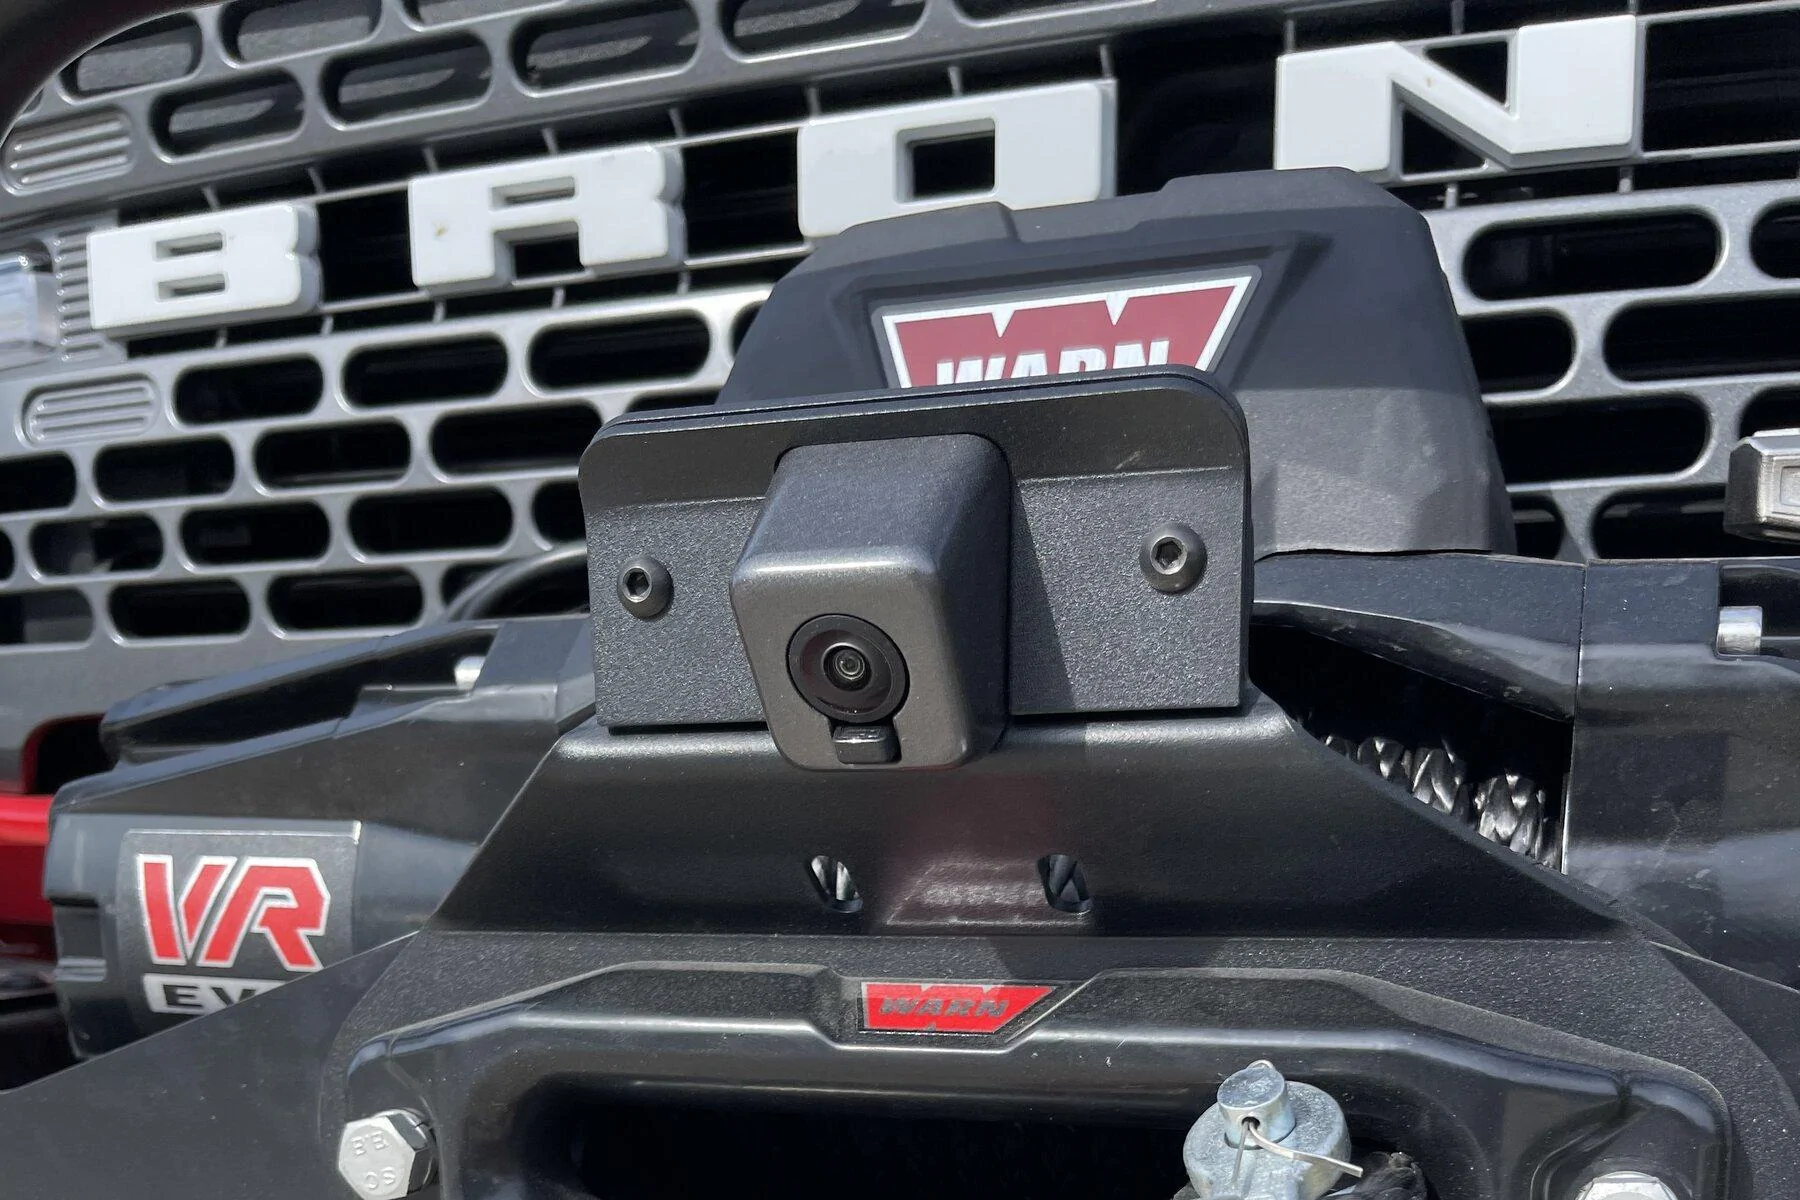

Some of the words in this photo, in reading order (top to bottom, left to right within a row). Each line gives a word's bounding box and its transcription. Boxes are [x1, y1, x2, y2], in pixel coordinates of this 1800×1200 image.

[88, 13, 1647, 333] BRON
[136, 853, 332, 973] VR
[879, 996, 1008, 1018] WARN
